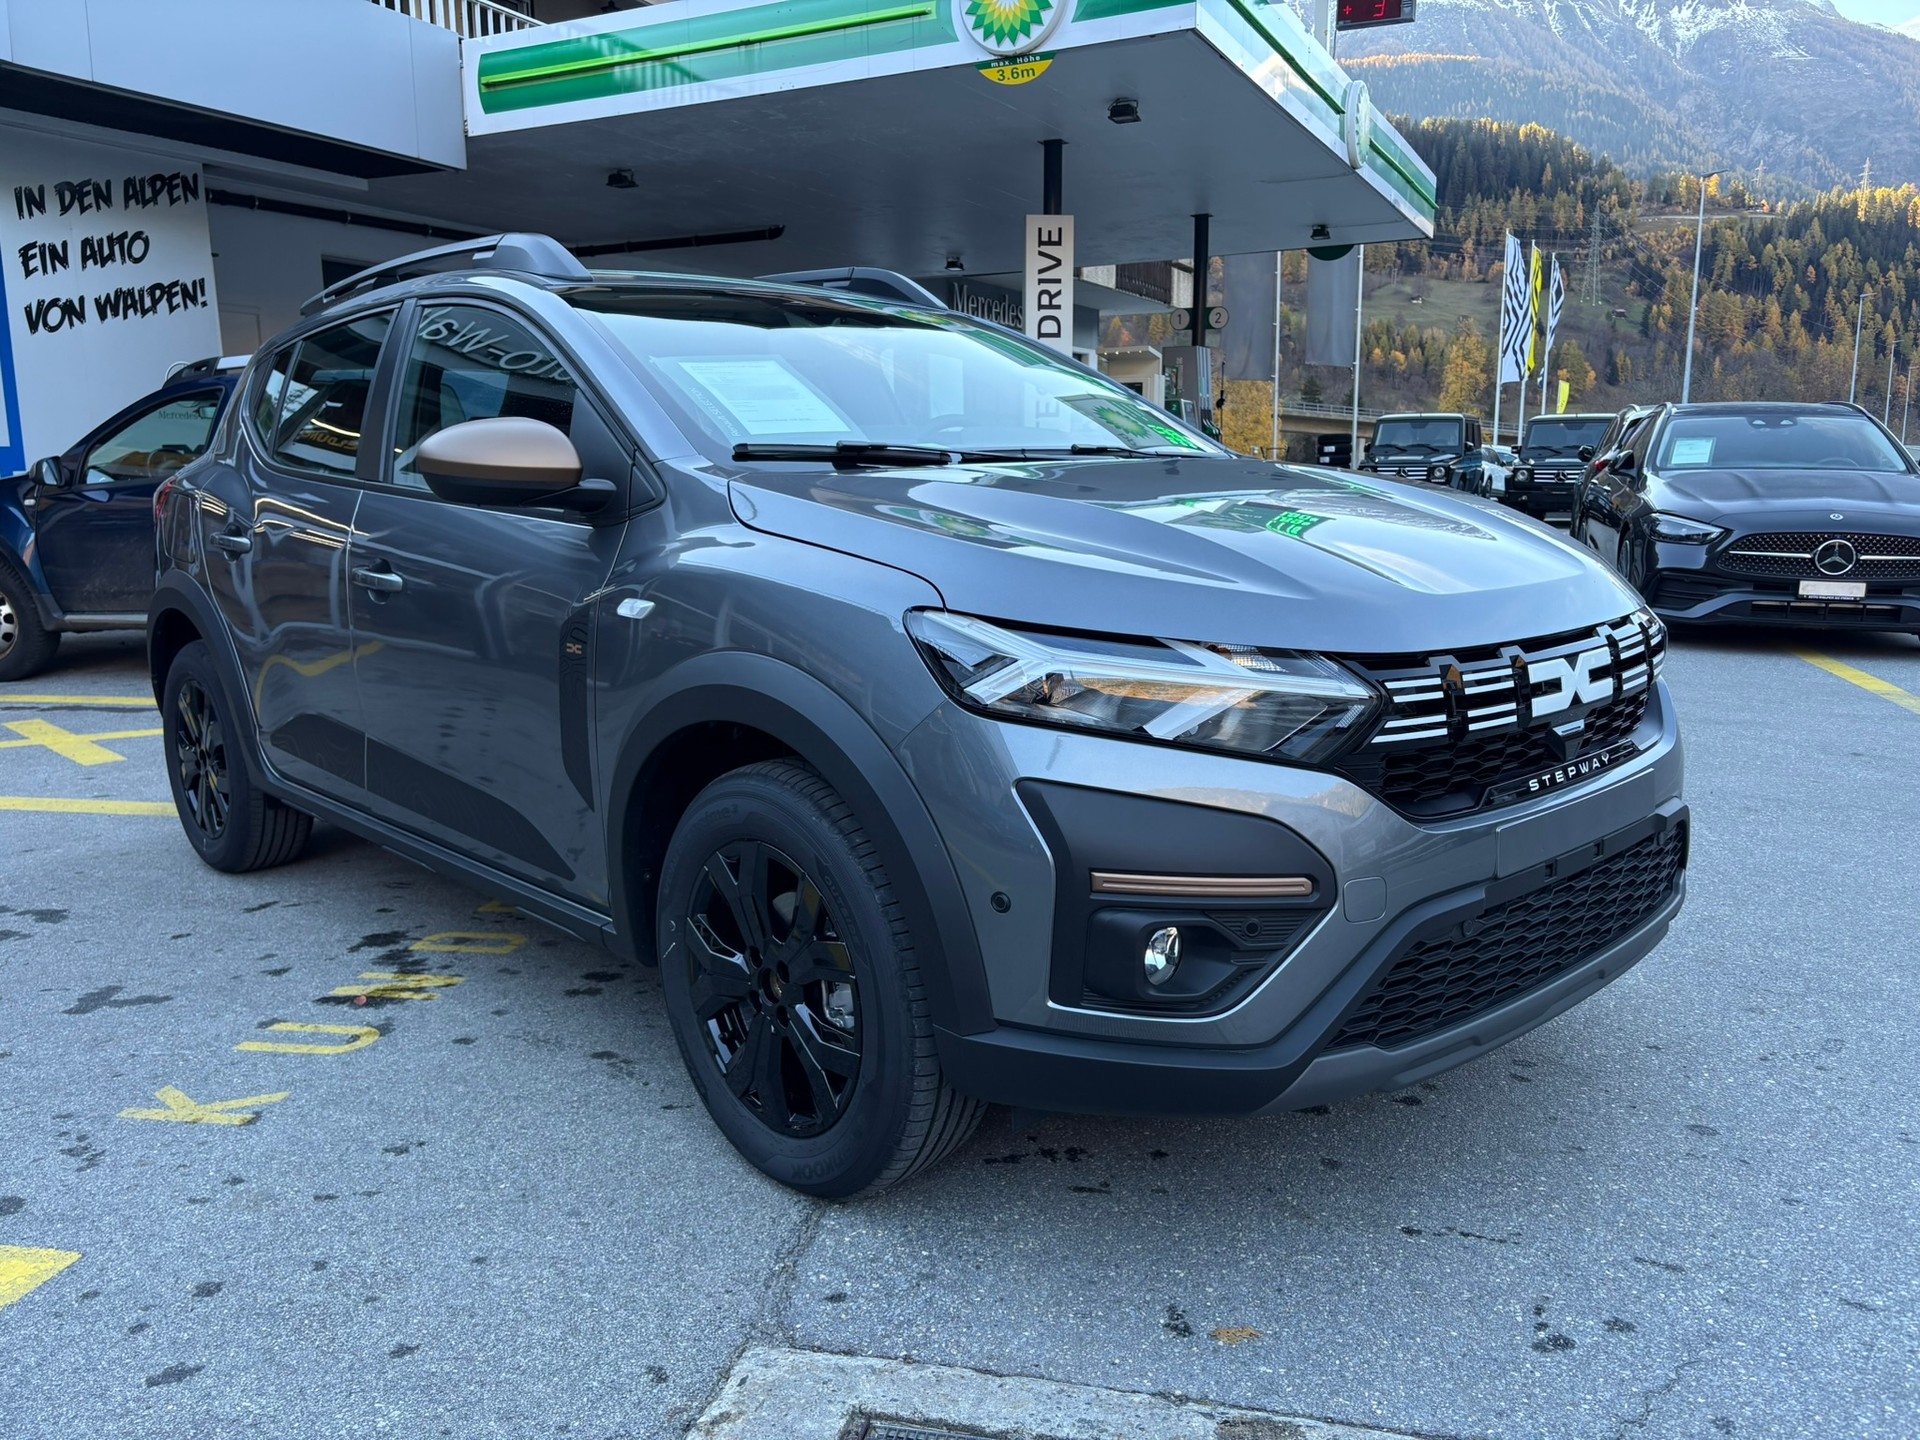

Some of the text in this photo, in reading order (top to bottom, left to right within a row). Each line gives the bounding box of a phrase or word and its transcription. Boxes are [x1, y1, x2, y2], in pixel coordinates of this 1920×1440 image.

[997, 67, 1036, 82] 3.6m
[1017, 55, 1041, 64] Höhe
[14, 171, 200, 221] IN DEN ALPEN
[18, 230, 150, 280] EIN AUTO
[1037, 226, 1063, 340] DRIVE
[24, 277, 208, 335] VON WALPEN!
[953, 282, 1023, 328] Mercedes
[1176, 313, 1182, 325] 1
[1214, 312, 1222, 324] 2
[1528, 753, 1610, 792] STEPWAY
